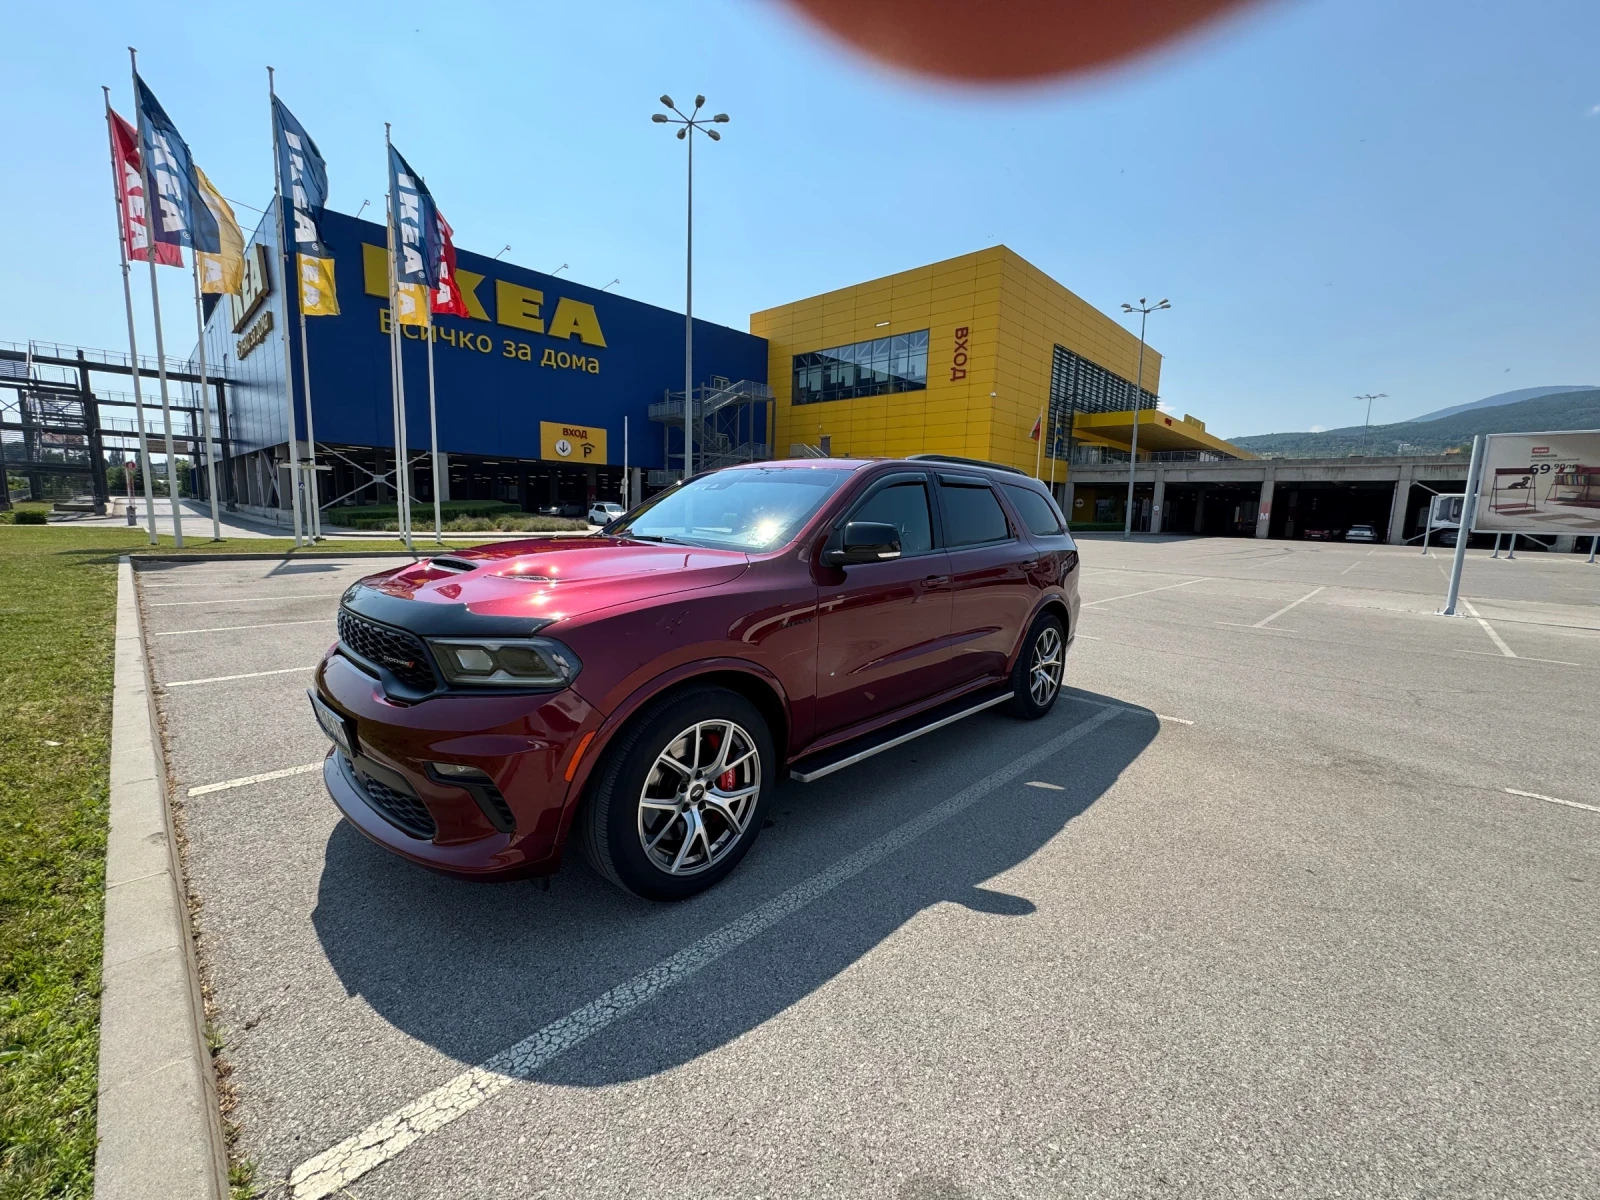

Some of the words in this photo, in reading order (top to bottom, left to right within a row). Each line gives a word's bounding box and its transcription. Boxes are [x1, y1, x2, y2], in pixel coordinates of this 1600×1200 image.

[123, 146, 148, 251] KEA
[152, 130, 187, 233] IKEA
[284, 129, 318, 243] IKEA
[397, 172, 425, 275] IKEA
[502, 340, 532, 361] за
[540, 348, 600, 374] дома
[950, 326, 969, 382] ВХОД
[562, 427, 588, 440] ВХОД
